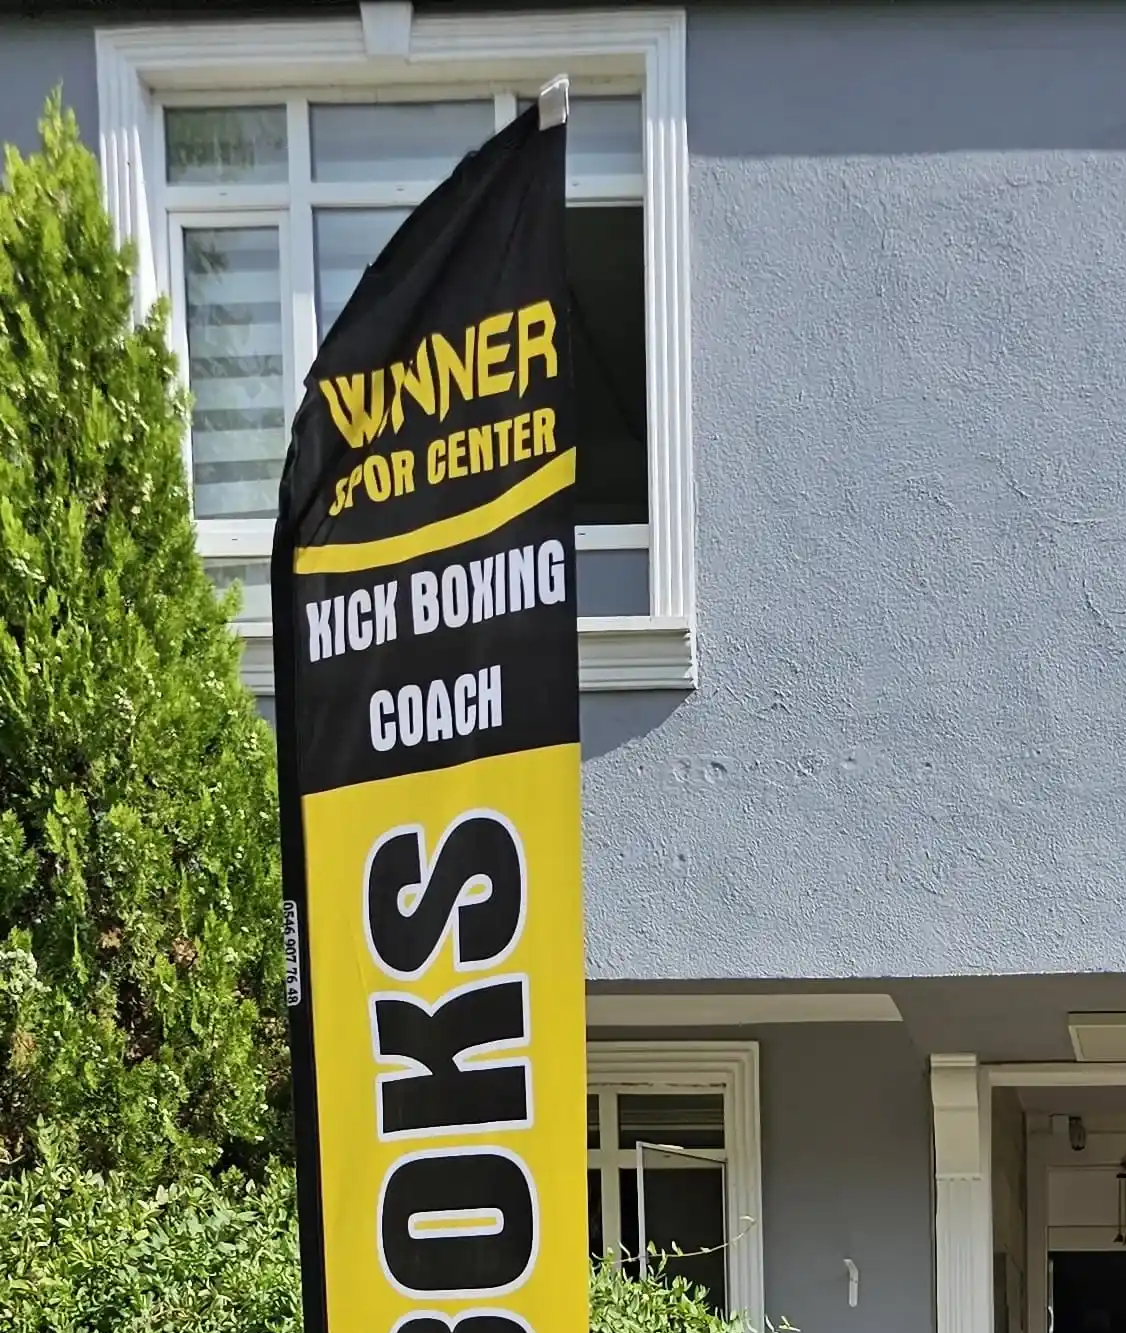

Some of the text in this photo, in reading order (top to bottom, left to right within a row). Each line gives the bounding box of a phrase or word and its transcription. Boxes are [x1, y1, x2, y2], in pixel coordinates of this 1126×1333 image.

[329, 408, 556, 516] SPOR CENTER
[306, 541, 566, 662] KICK BOXING
[370, 666, 502, 751] COACH
[283, 902, 299, 1004] 0546 907 76 48
